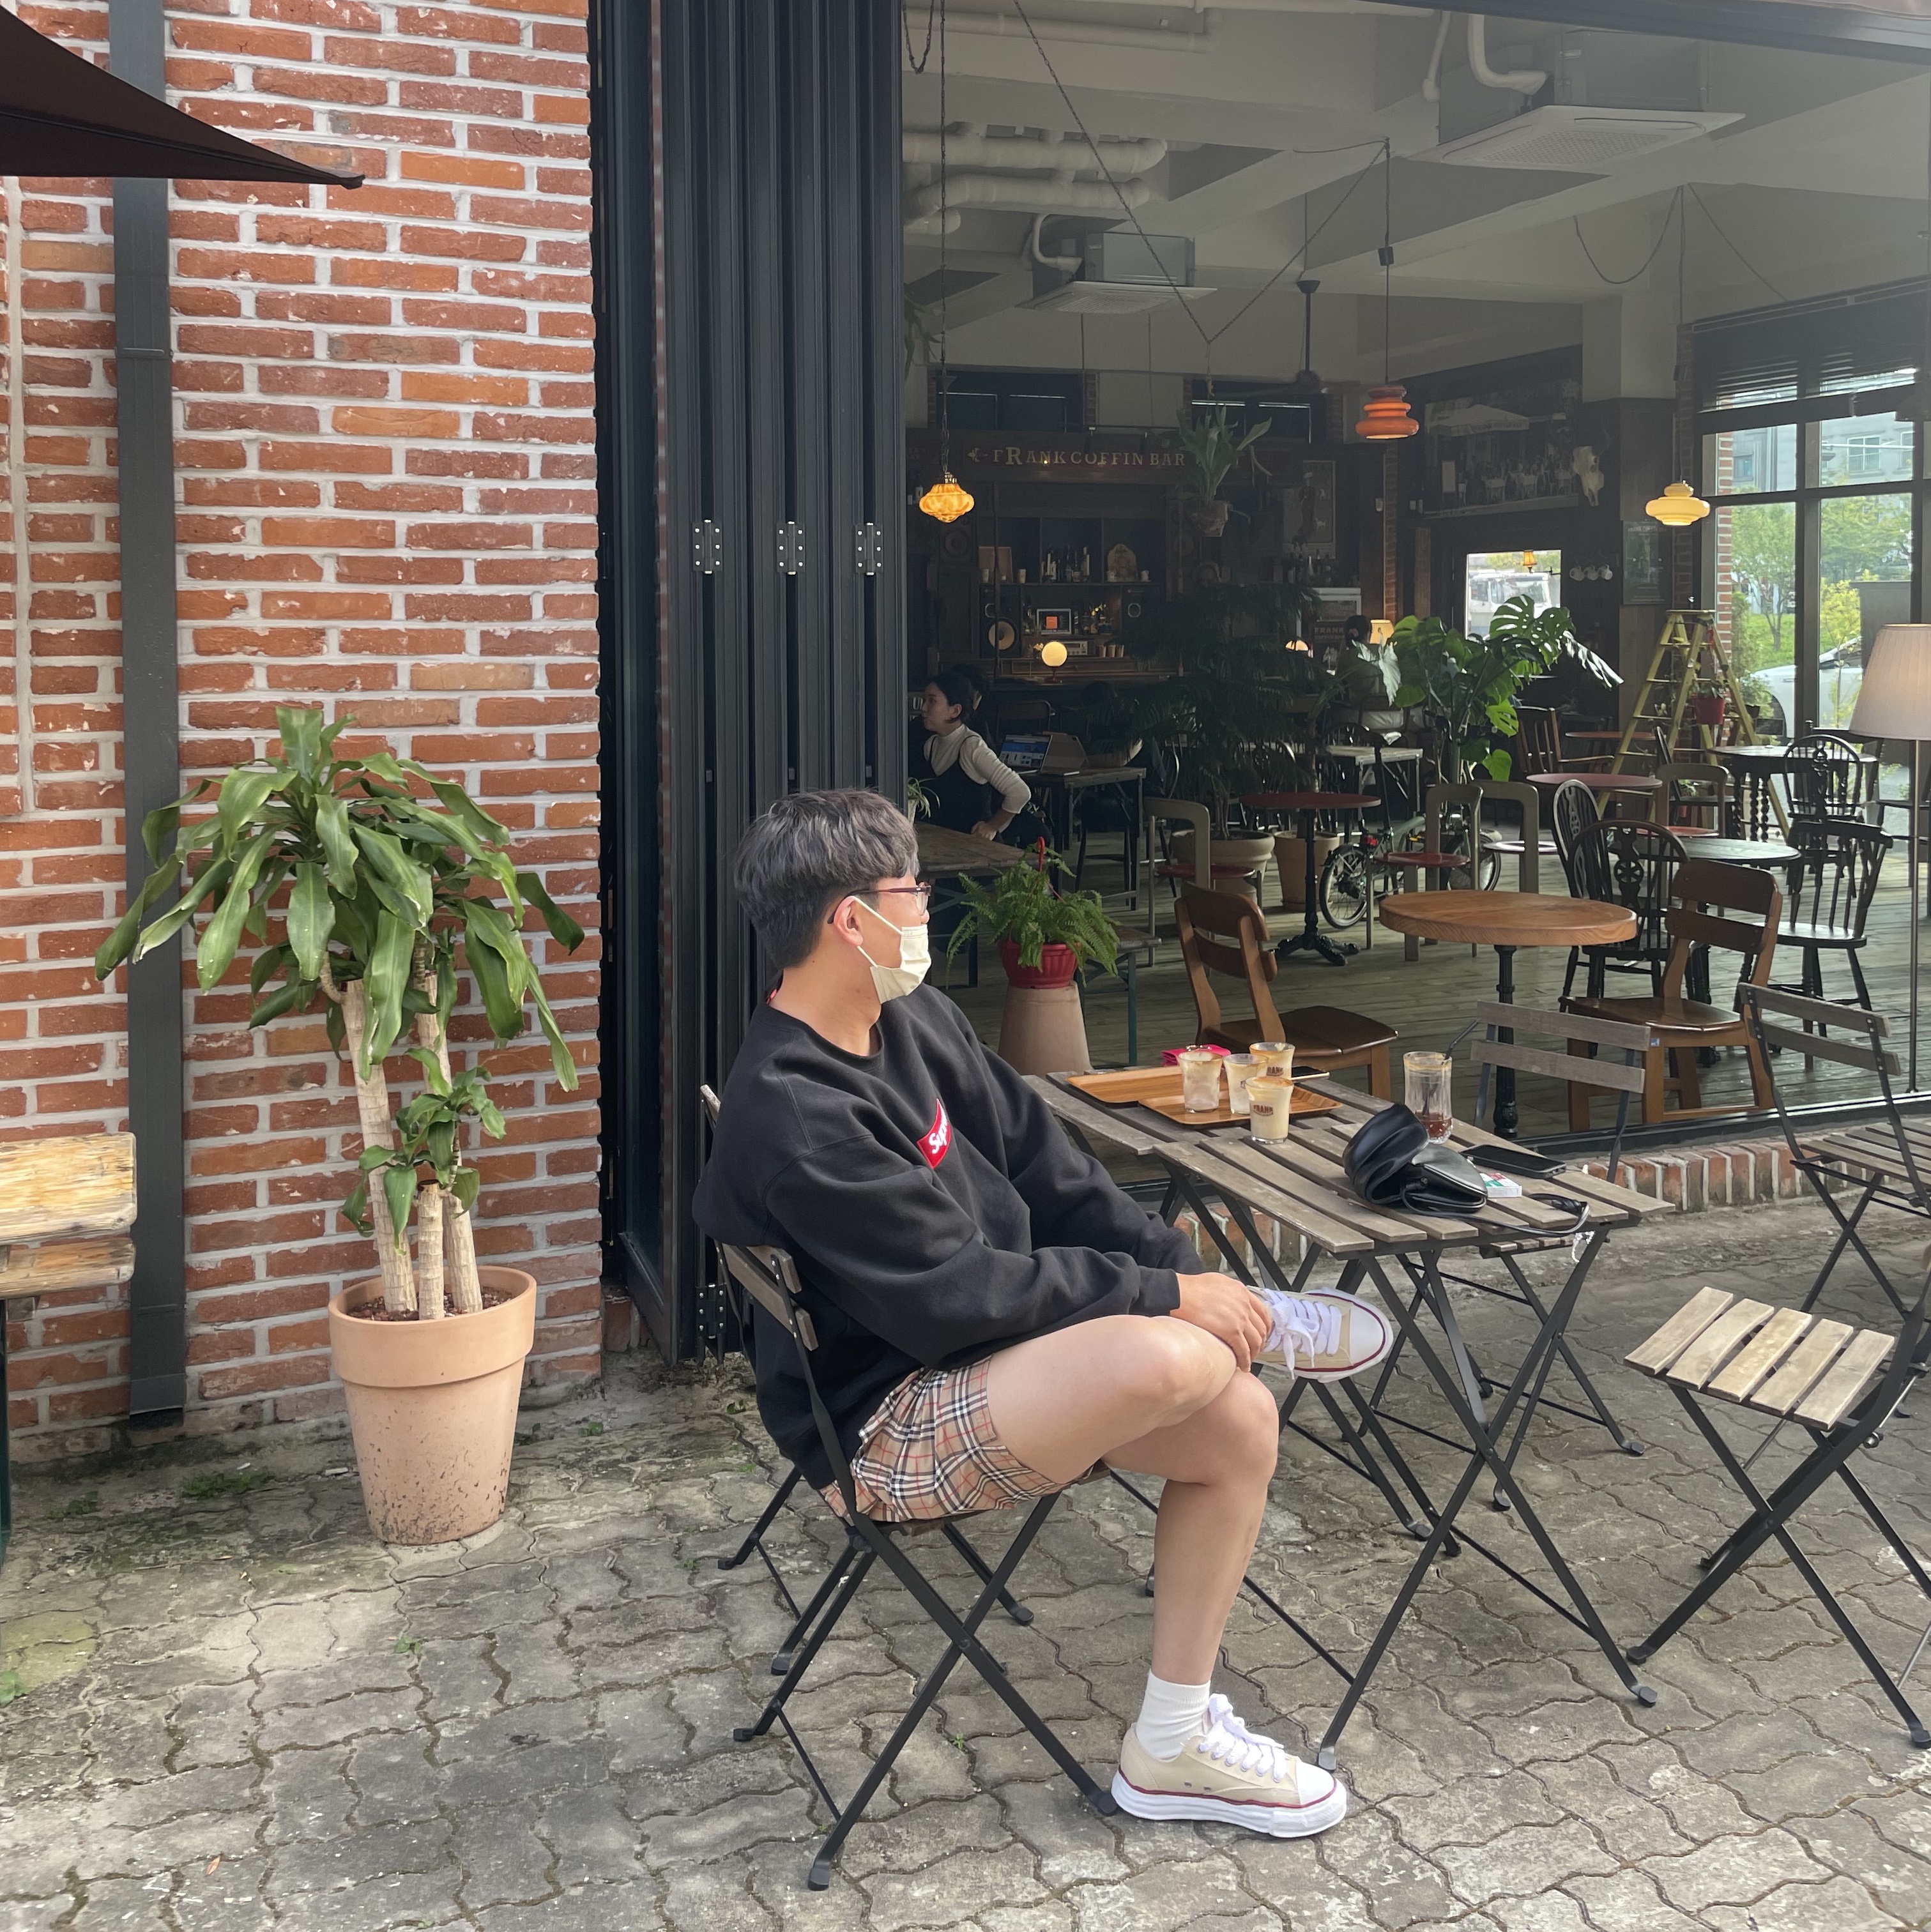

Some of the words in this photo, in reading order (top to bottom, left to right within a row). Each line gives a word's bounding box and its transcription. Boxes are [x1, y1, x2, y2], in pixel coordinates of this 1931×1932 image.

[993, 446, 1066, 466] FRANK
[1071, 452, 1143, 466] COFFIN
[1149, 453, 1185, 467] BAR
[1253, 1104, 1274, 1114] FRANK
